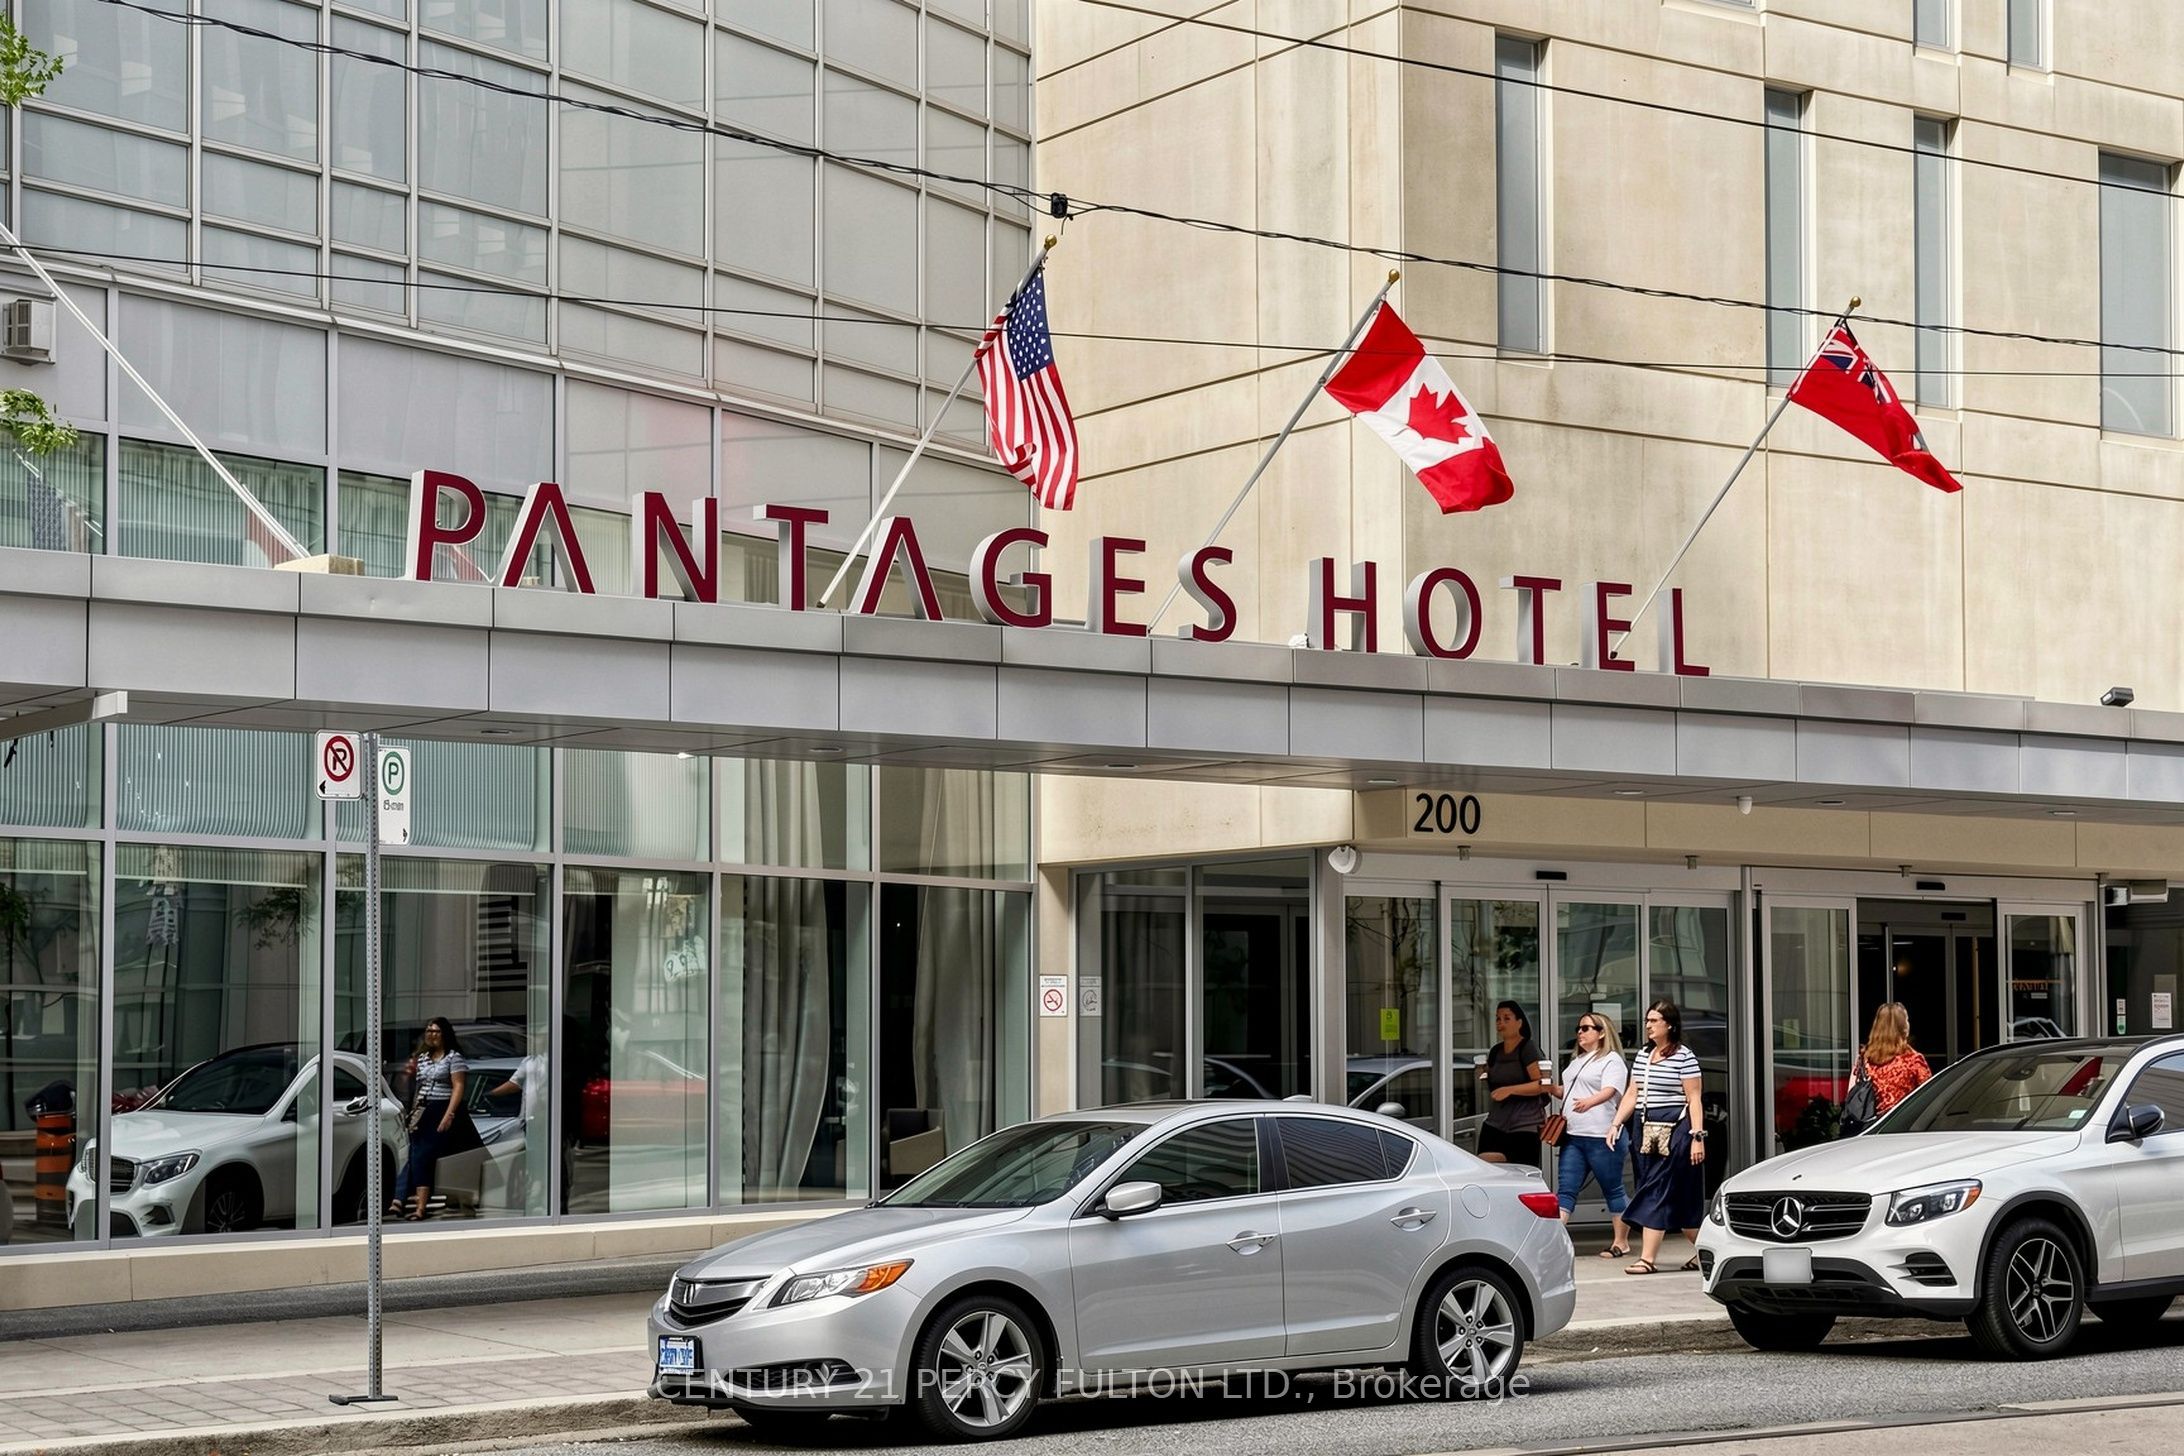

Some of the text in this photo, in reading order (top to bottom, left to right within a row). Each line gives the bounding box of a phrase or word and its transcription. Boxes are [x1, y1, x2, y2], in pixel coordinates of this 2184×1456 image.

[411, 469, 1711, 677] PANTAGES HOTEL
[1413, 792, 1481, 834] 200
